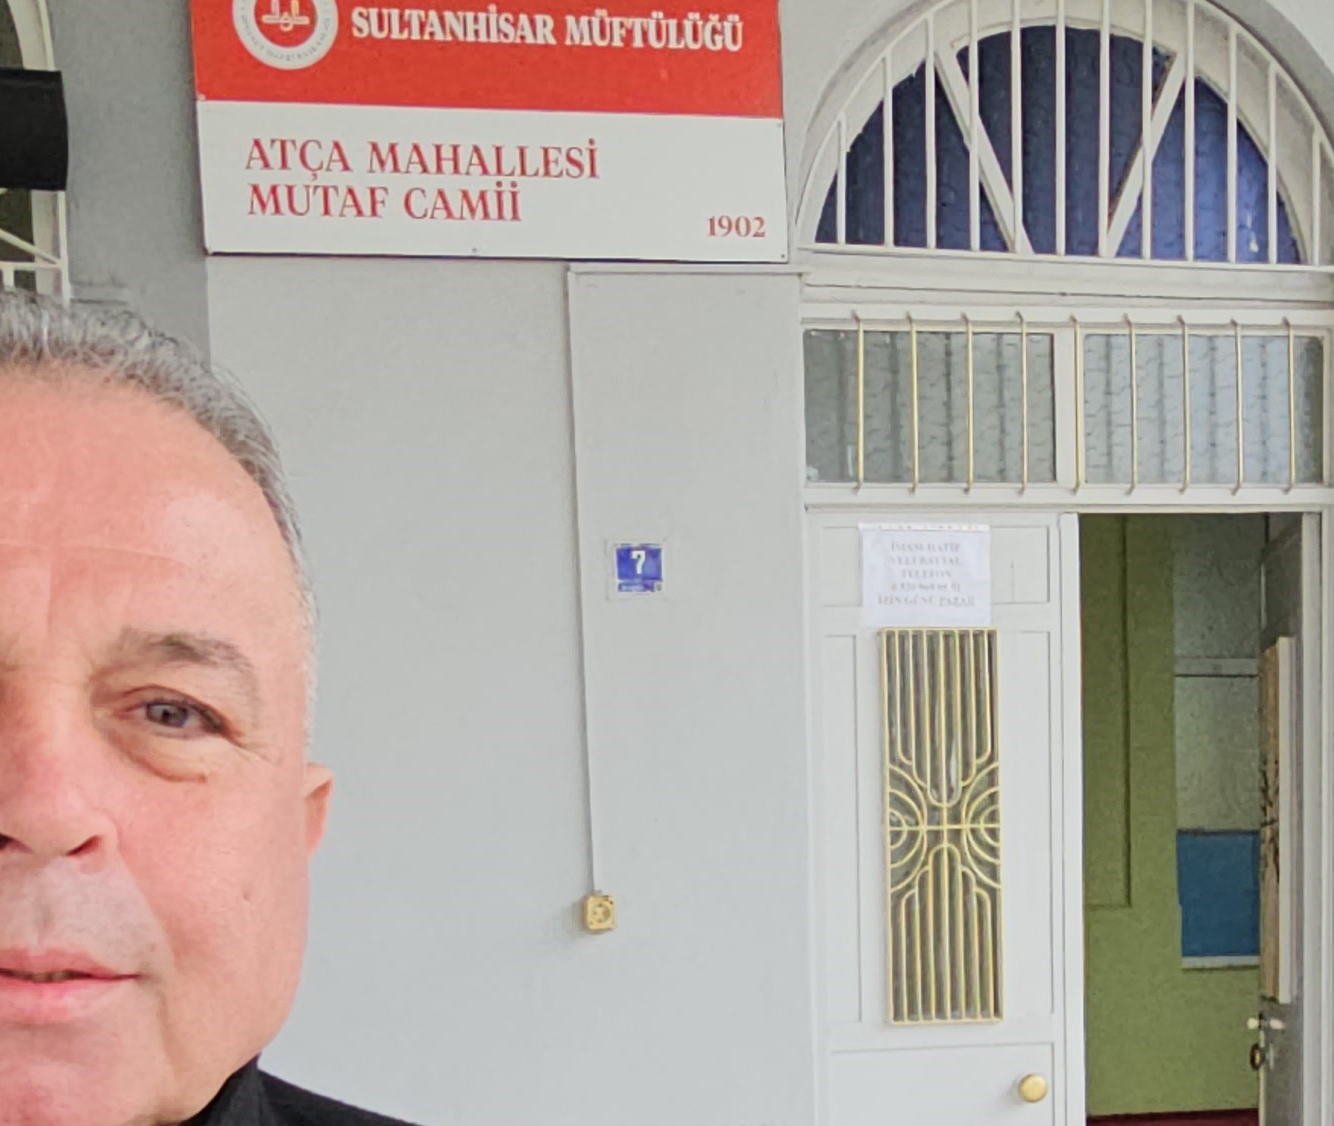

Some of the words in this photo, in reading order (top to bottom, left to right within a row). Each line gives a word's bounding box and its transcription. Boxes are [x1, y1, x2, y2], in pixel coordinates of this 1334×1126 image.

[351, 4, 557, 45] SULTANHİSAR
[565, 8, 744, 52] MÜFTÜLÜĞÜ
[245, 138, 353, 181] ATÇA
[367, 138, 600, 179] MAHALLESİ
[247, 183, 389, 218] MUTAF
[403, 181, 523, 222] CAMİİ
[707, 214, 766, 238] 1902
[631, 550, 646, 575] 7
